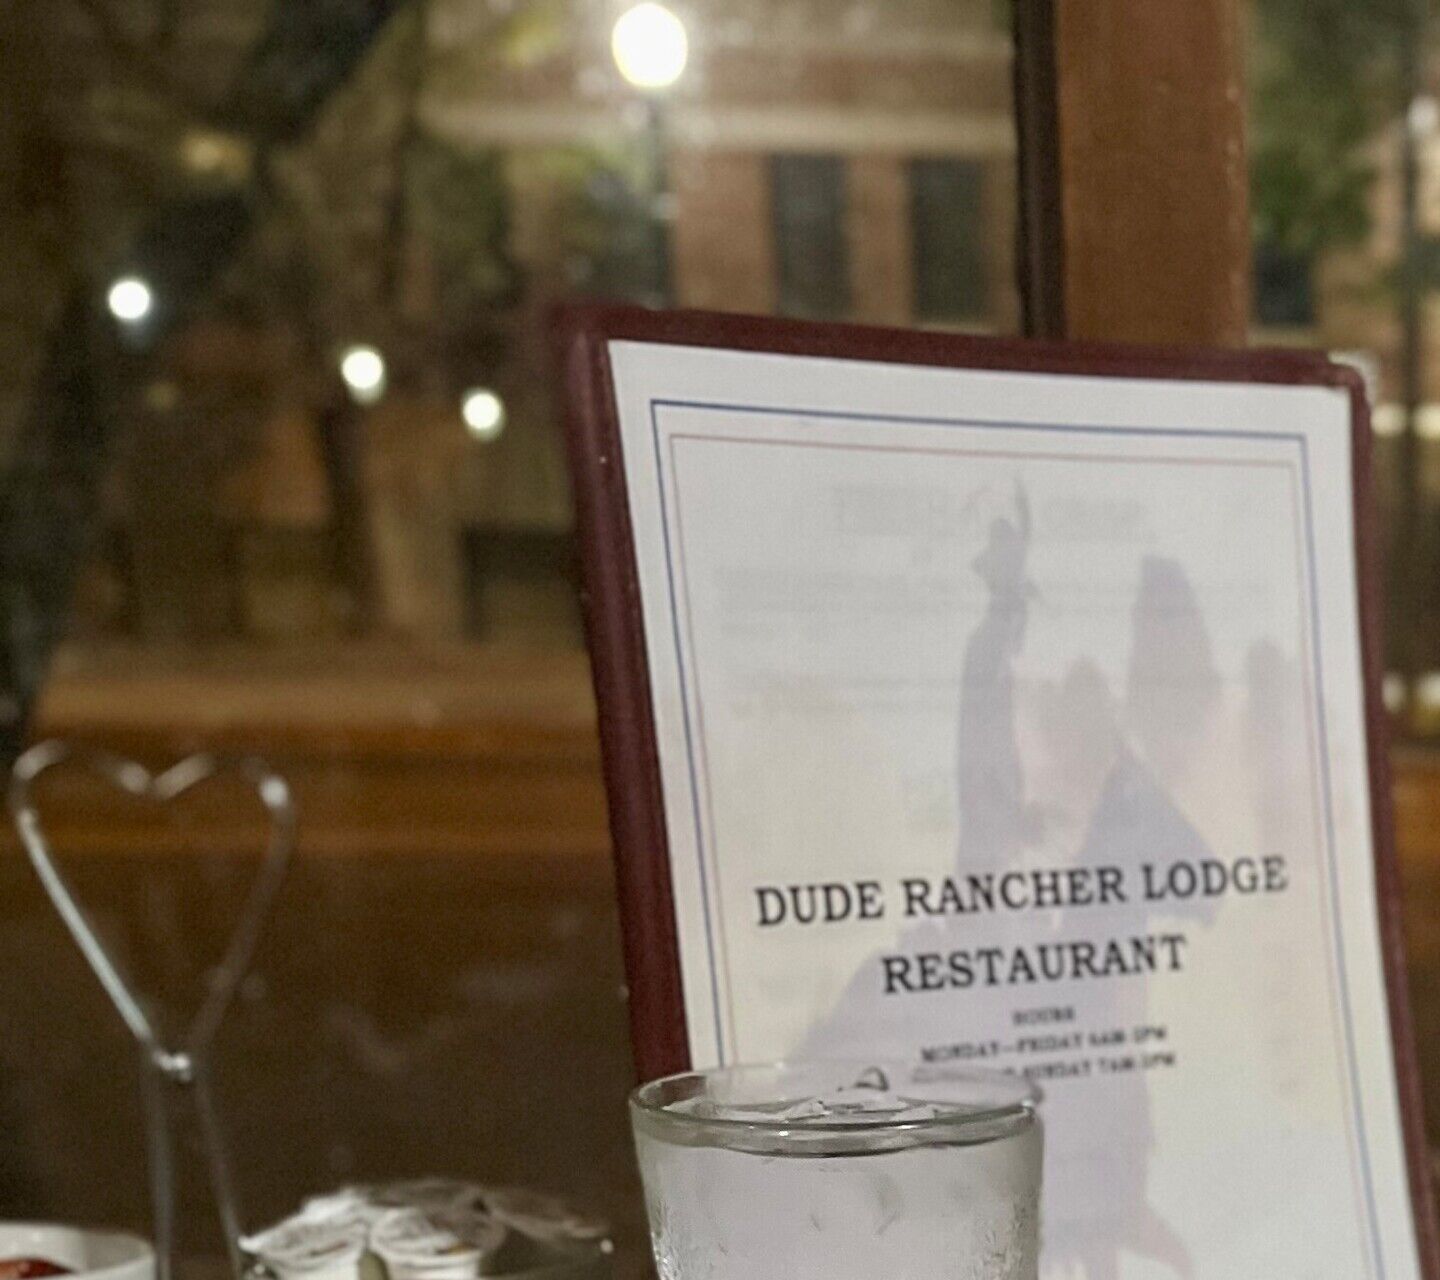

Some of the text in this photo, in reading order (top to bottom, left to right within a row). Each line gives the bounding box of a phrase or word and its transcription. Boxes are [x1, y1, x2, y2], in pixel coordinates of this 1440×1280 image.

[755, 856, 1288, 926] DUDE RANCHER LODGE
[881, 936, 1186, 995] RESTAURANT
[1012, 1007, 1075, 1025] HOURS
